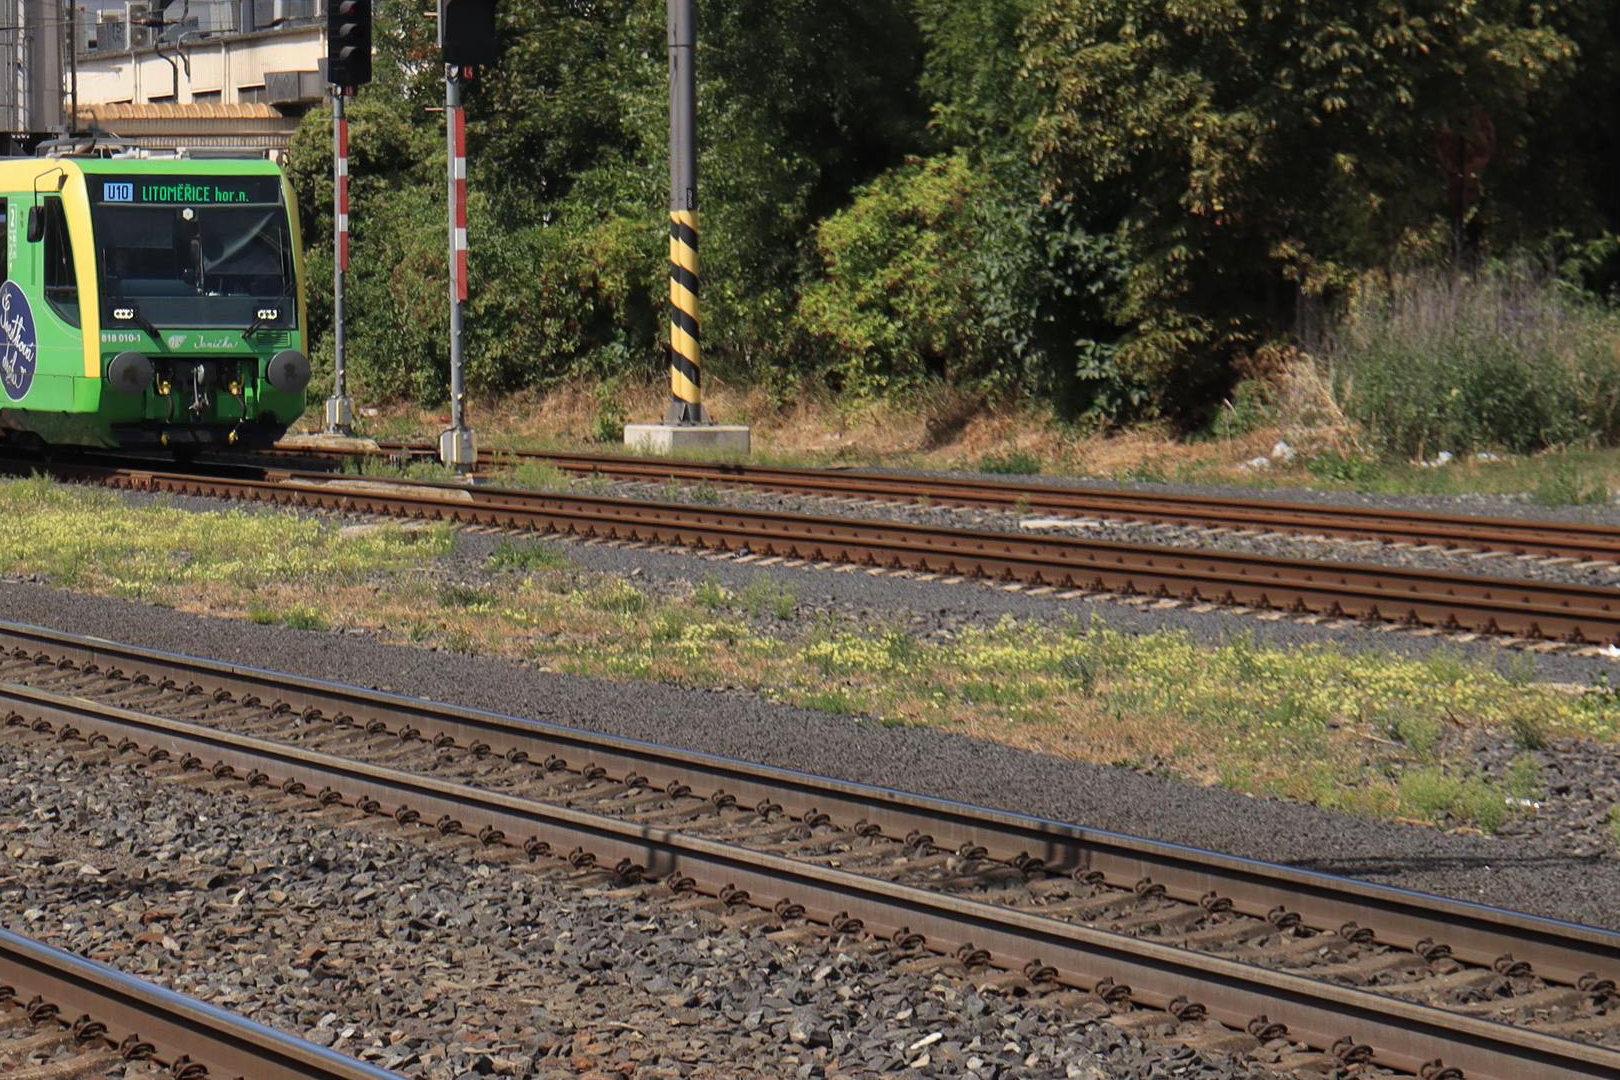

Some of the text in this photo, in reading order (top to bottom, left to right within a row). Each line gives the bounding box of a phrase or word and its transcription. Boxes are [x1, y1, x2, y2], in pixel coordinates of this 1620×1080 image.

[107, 183, 250, 202] U10 LITOMĚŘICE hor.n.
